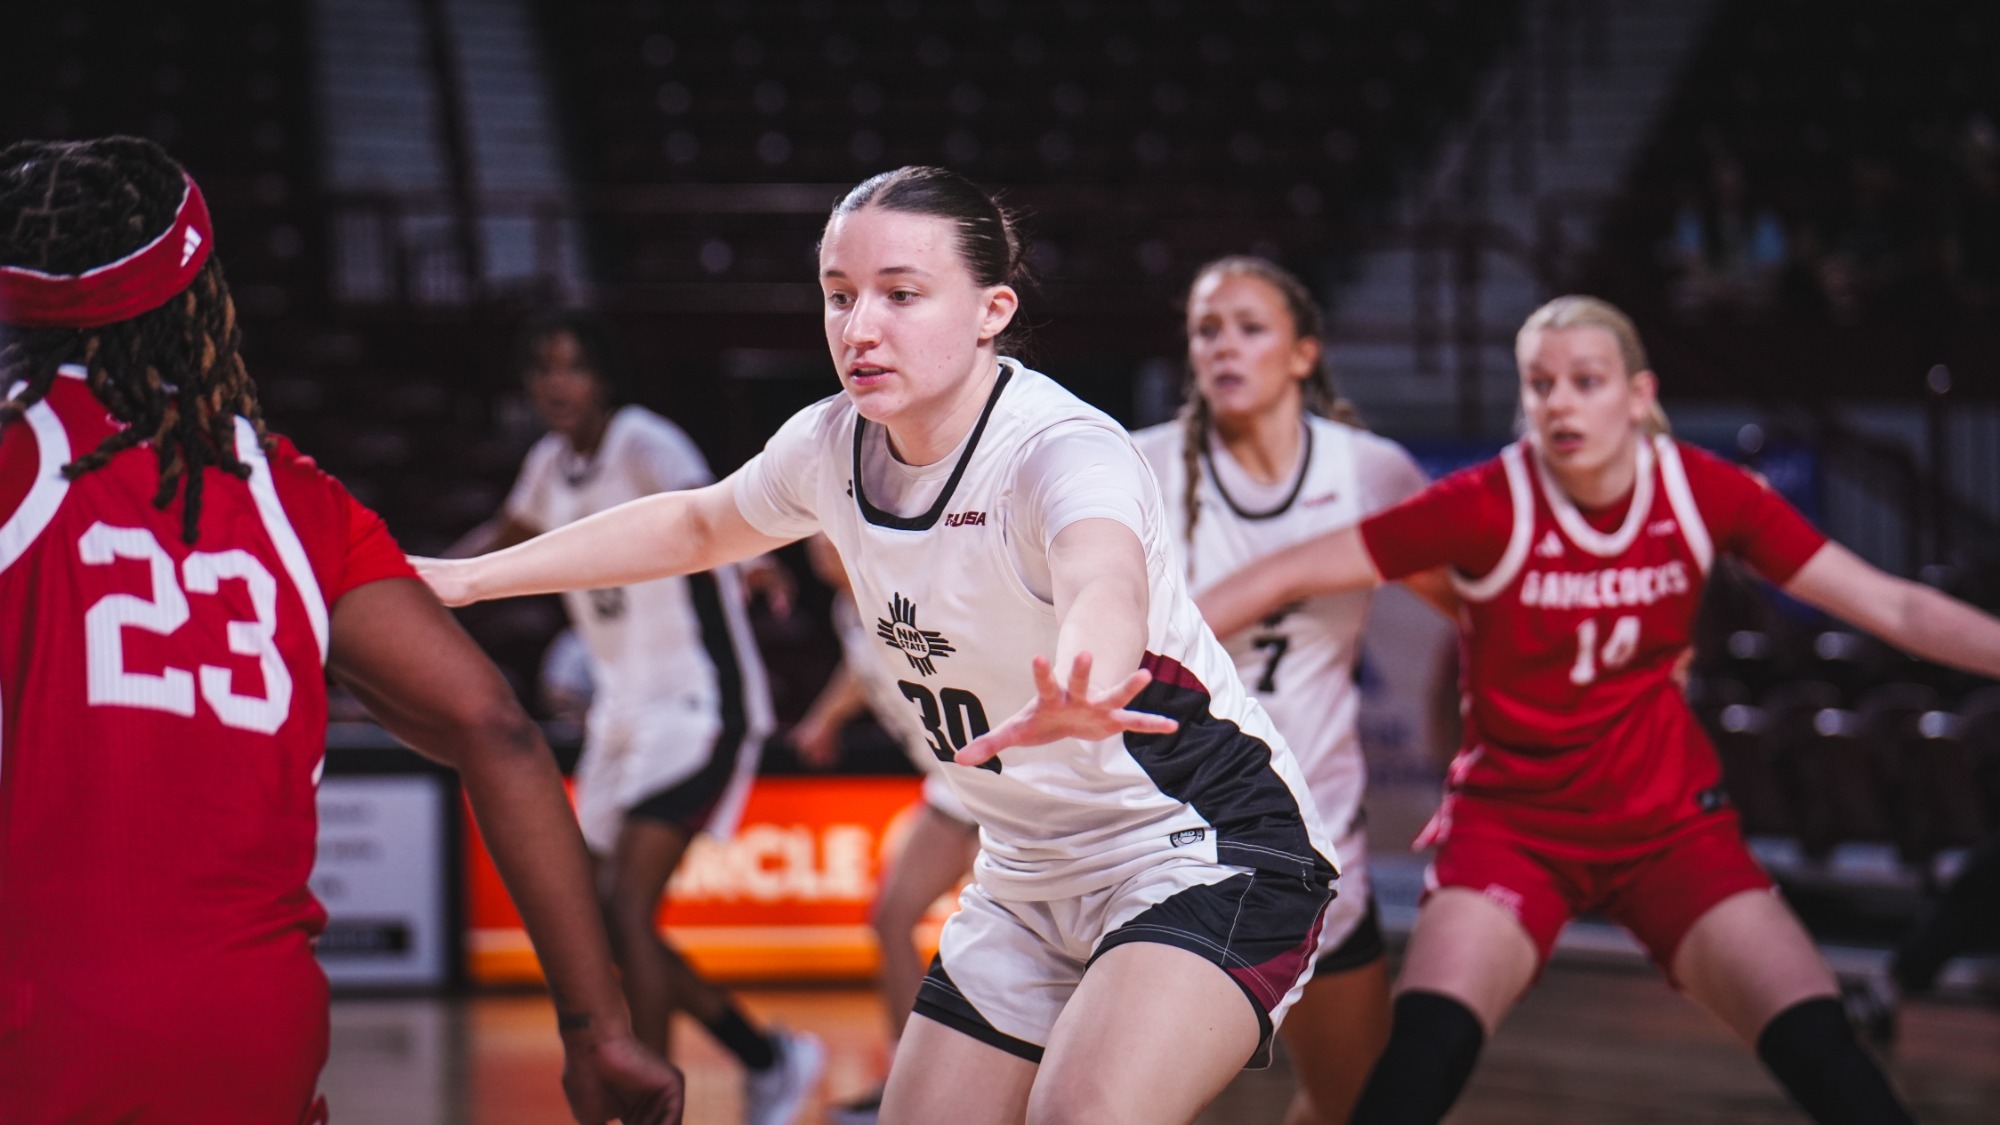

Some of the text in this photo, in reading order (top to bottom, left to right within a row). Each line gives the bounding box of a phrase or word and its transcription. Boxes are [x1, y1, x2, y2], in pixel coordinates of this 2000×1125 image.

[78, 520, 293, 735] 23
[896, 627, 923, 643] NM
[900, 640, 927, 652] STATE
[1253, 635, 1289, 693] 7
[897, 679, 1002, 775] 30
